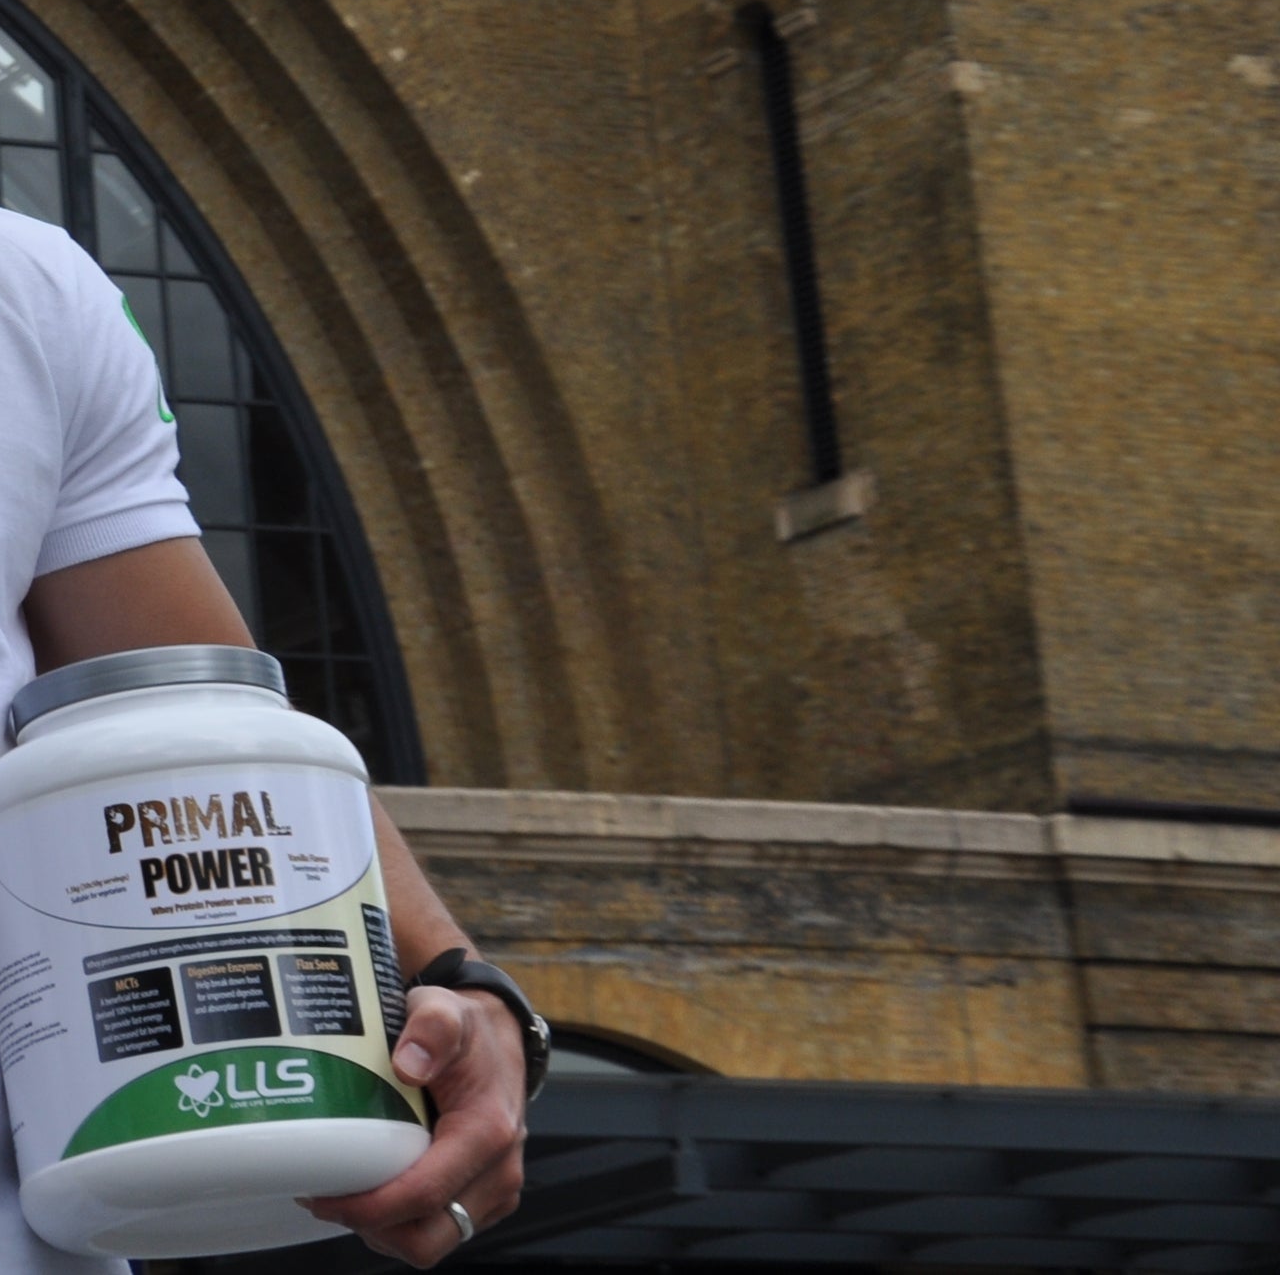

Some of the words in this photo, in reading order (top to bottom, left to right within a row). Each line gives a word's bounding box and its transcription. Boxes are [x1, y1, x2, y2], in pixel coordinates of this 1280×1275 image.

[104, 791, 293, 854] PRIMAL
[139, 846, 277, 899] POWER
[150, 905, 174, 916] Whey
[175, 901, 205, 912] Protein
[205, 898, 235, 909] Powder
[235, 896, 253, 905] with
[187, 965, 227, 978] Digestive
[227, 962, 264, 974] Enzymes
[296, 958, 314, 970] Flax
[314, 958, 340, 971] Seeds
[115, 977, 140, 991] MCTs
[210, 977, 228, 987] break
[228, 977, 246, 985] down
[246, 975, 261, 984] food
[105, 992, 131, 1004] beneficial
[131, 991, 140, 999] fat
[140, 989, 159, 998] source
[196, 994, 206, 1002] for
[206, 990, 235, 1001] improved
[236, 988, 264, 998] digestion
[132, 1003, 146, 1012] from
[146, 999, 171, 1010] coconut
[195, 1005, 207, 1015] and
[208, 1002, 240, 1013] absorption
[240, 1001, 247, 1009] of
[143, 1014, 163, 1024] energy
[147, 1024, 172, 1035] burning
[226, 1058, 315, 1100] LLS
[230, 1100, 249, 1109] LOVE
[250, 1099, 264, 1108] LIFE
[265, 1096, 314, 1106] SUPPLEMENTS
